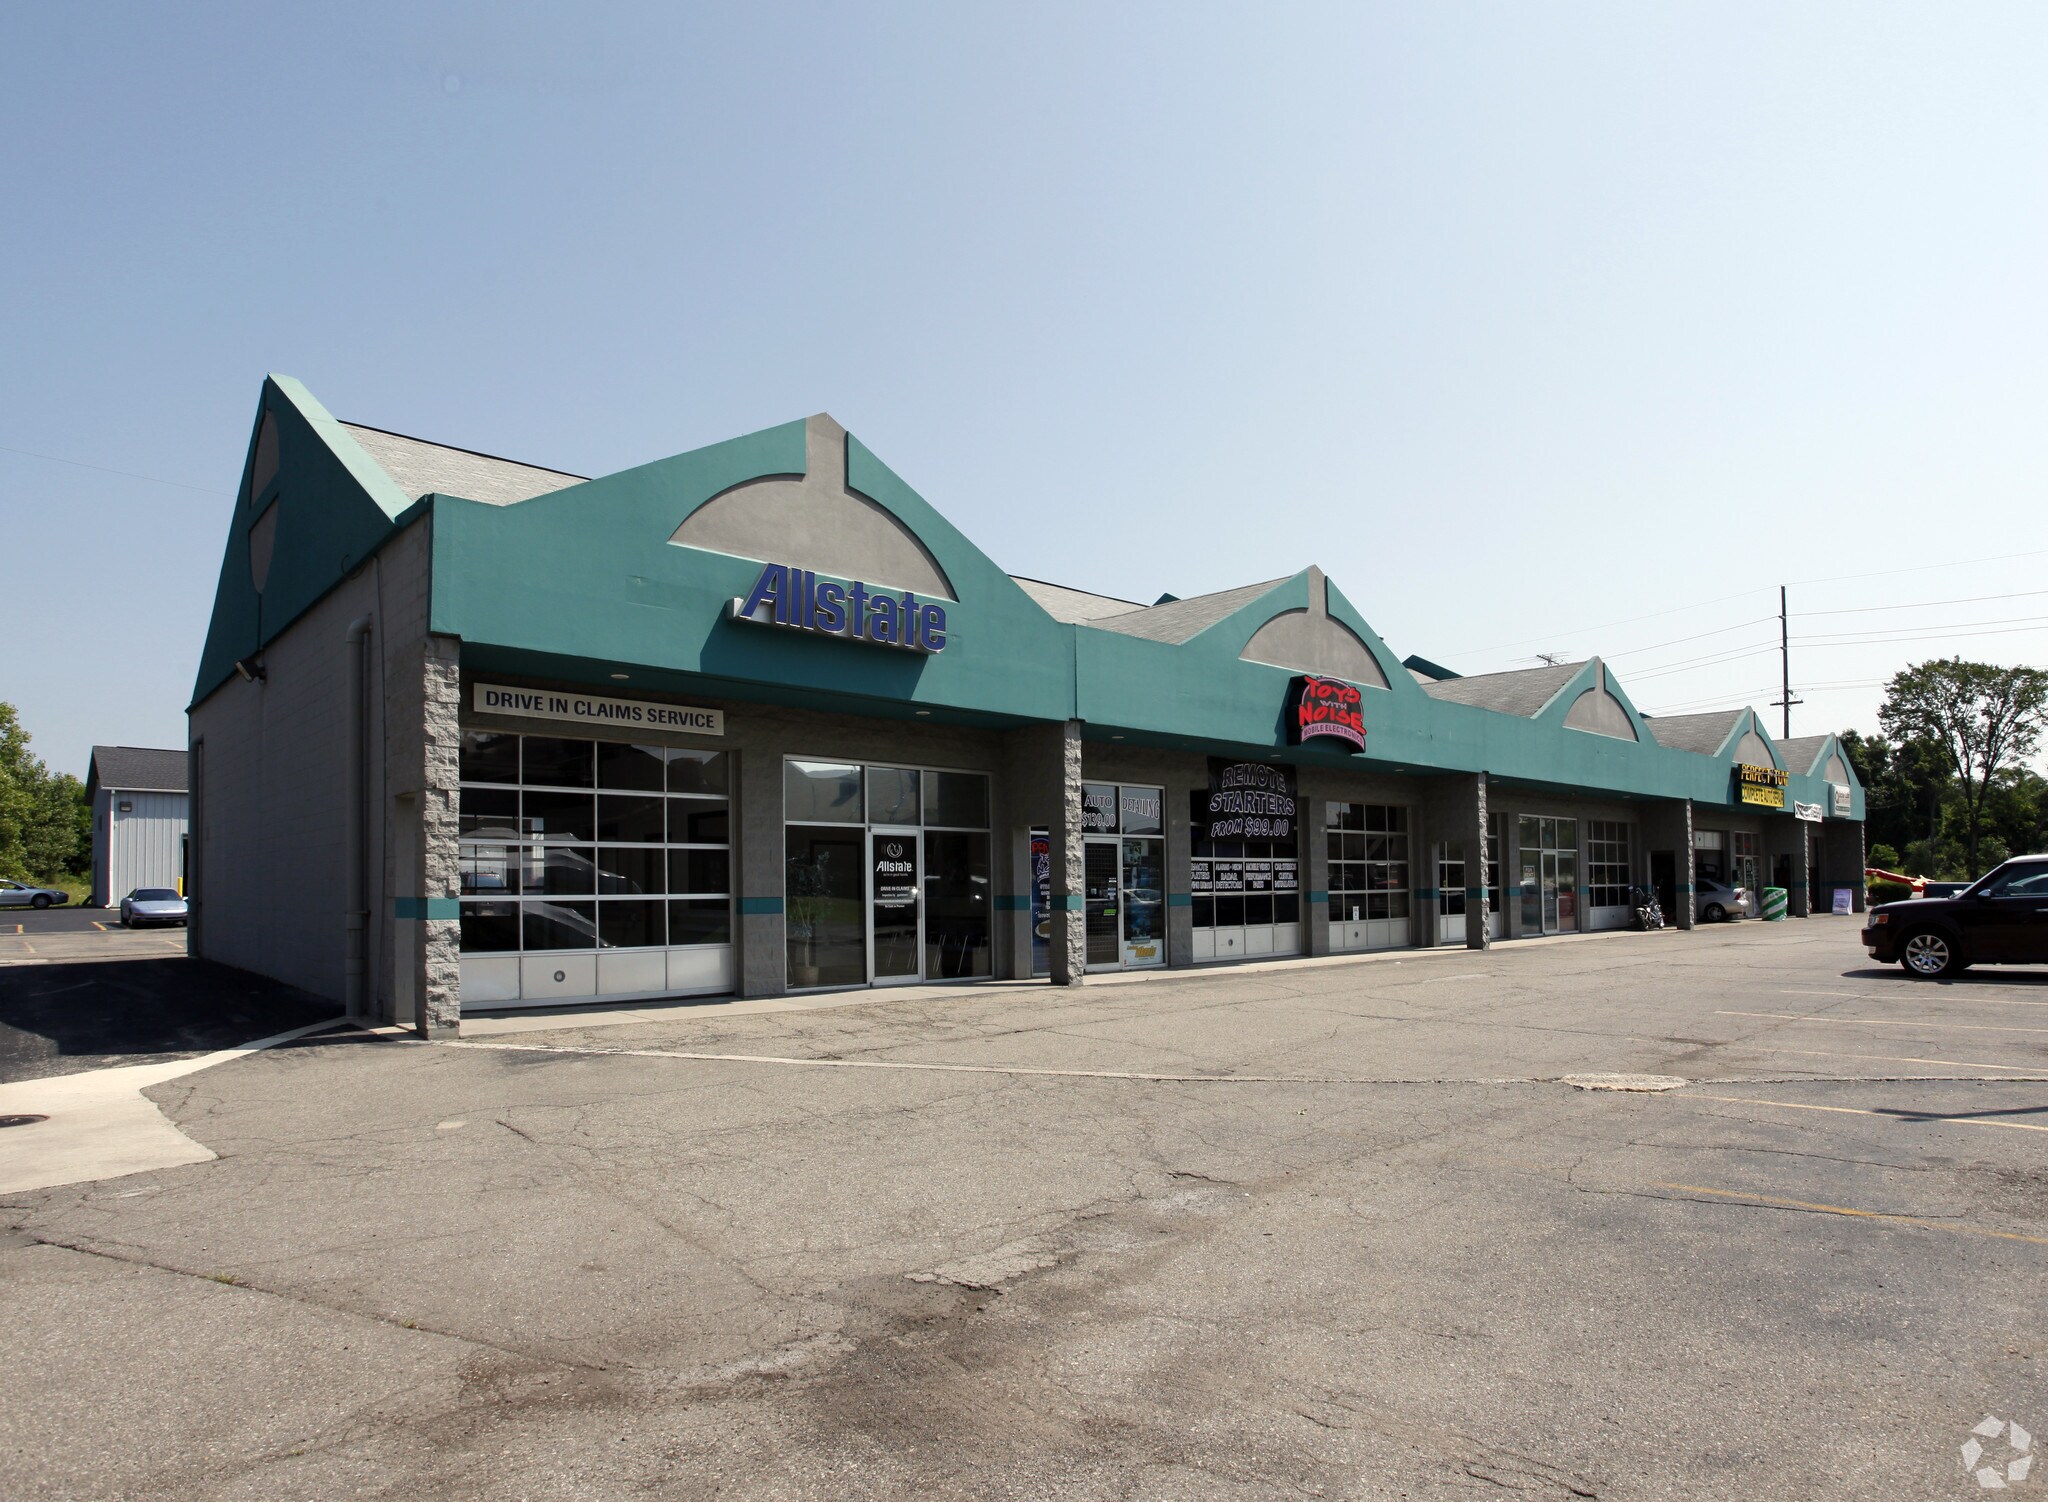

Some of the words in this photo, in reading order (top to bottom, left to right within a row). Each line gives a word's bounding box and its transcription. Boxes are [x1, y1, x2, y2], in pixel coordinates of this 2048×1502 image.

[739, 562, 946, 653] Allstate
[1304, 676, 1361, 703] TOYS
[486, 690, 544, 711] DRIVE
[549, 697, 568, 713] IN
[574, 700, 642, 721] CLAIMS
[647, 708, 715, 728] SERVICE
[1320, 700, 1347, 709] WITH
[1299, 701, 1367, 735] NOISE
[1303, 724, 1324, 737] MOBILE
[1325, 724, 1363, 745] ELECTRONICS
[1222, 764, 1286, 793] REMOTE
[1084, 795, 1113, 808] AUTO
[1122, 797, 1160, 820] DETAILING
[1210, 791, 1295, 815] STARTERS
[1081, 811, 1116, 828] $139.00
[1211, 818, 1243, 837] FROM
[1245, 816, 1289, 837] $99.00
[876, 861, 912, 872] Allstate
